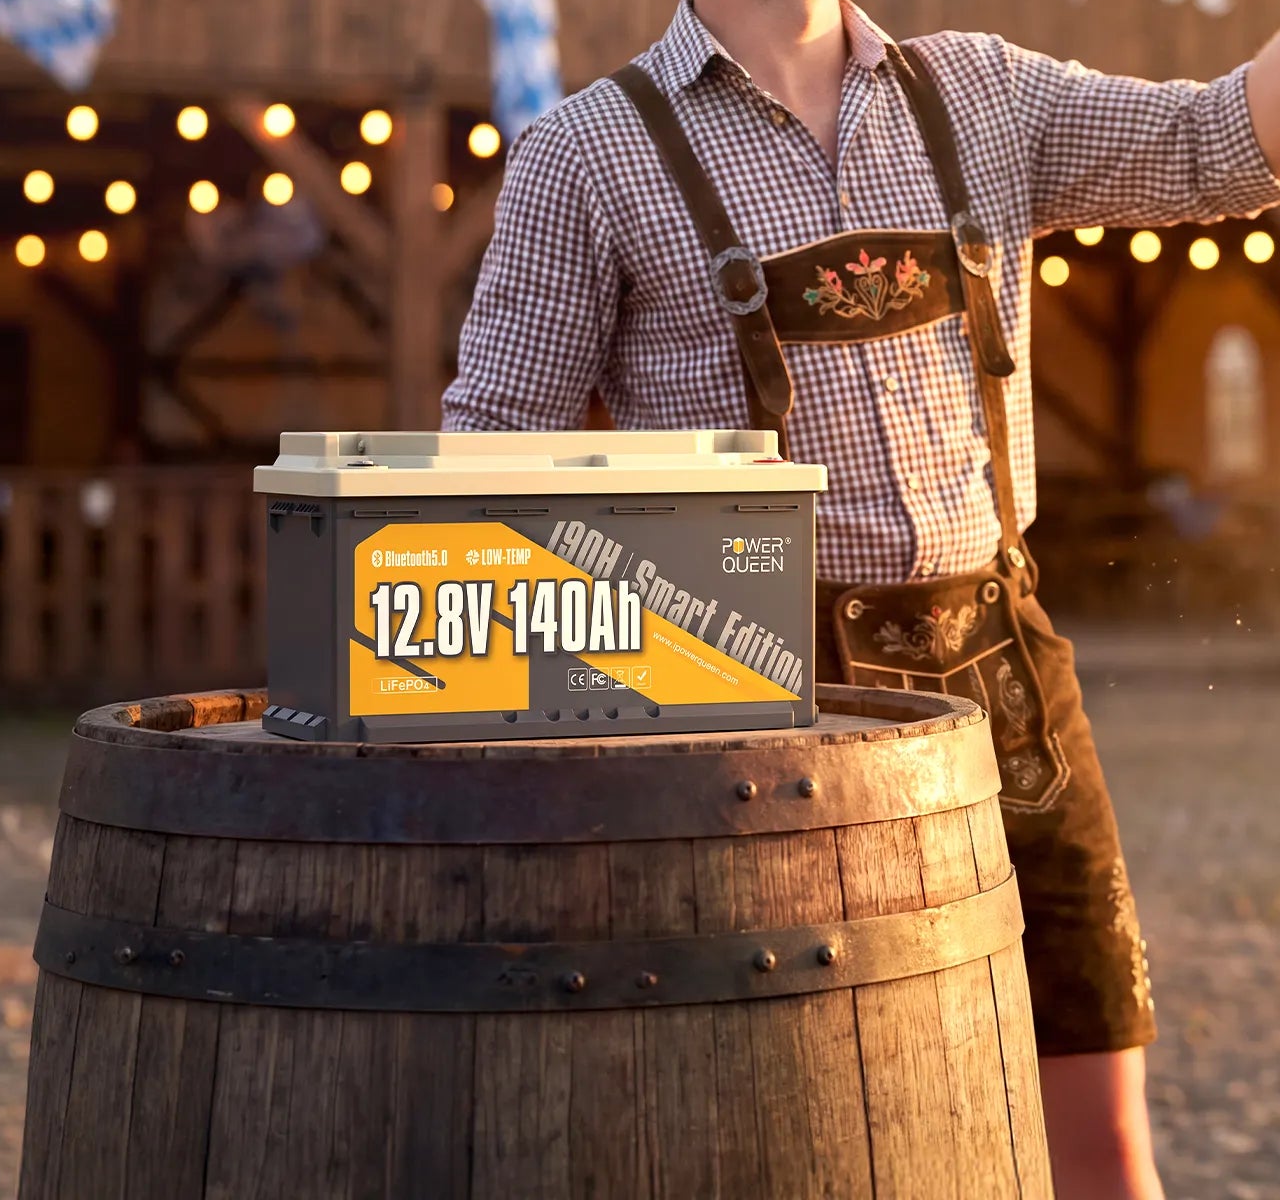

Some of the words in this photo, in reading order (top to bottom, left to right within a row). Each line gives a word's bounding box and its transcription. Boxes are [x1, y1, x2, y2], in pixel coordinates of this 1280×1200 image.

[481, 548, 532, 566] LOW-TEMP
[722, 555, 784, 573] QUEEN
[631, 559, 719, 641] Smart
[371, 580, 495, 658] 12.8V
[509, 579, 642, 655] 140Ah
[652, 631, 739, 686] www.ipowerqueen.com
[380, 679, 430, 692] LiFePO4
